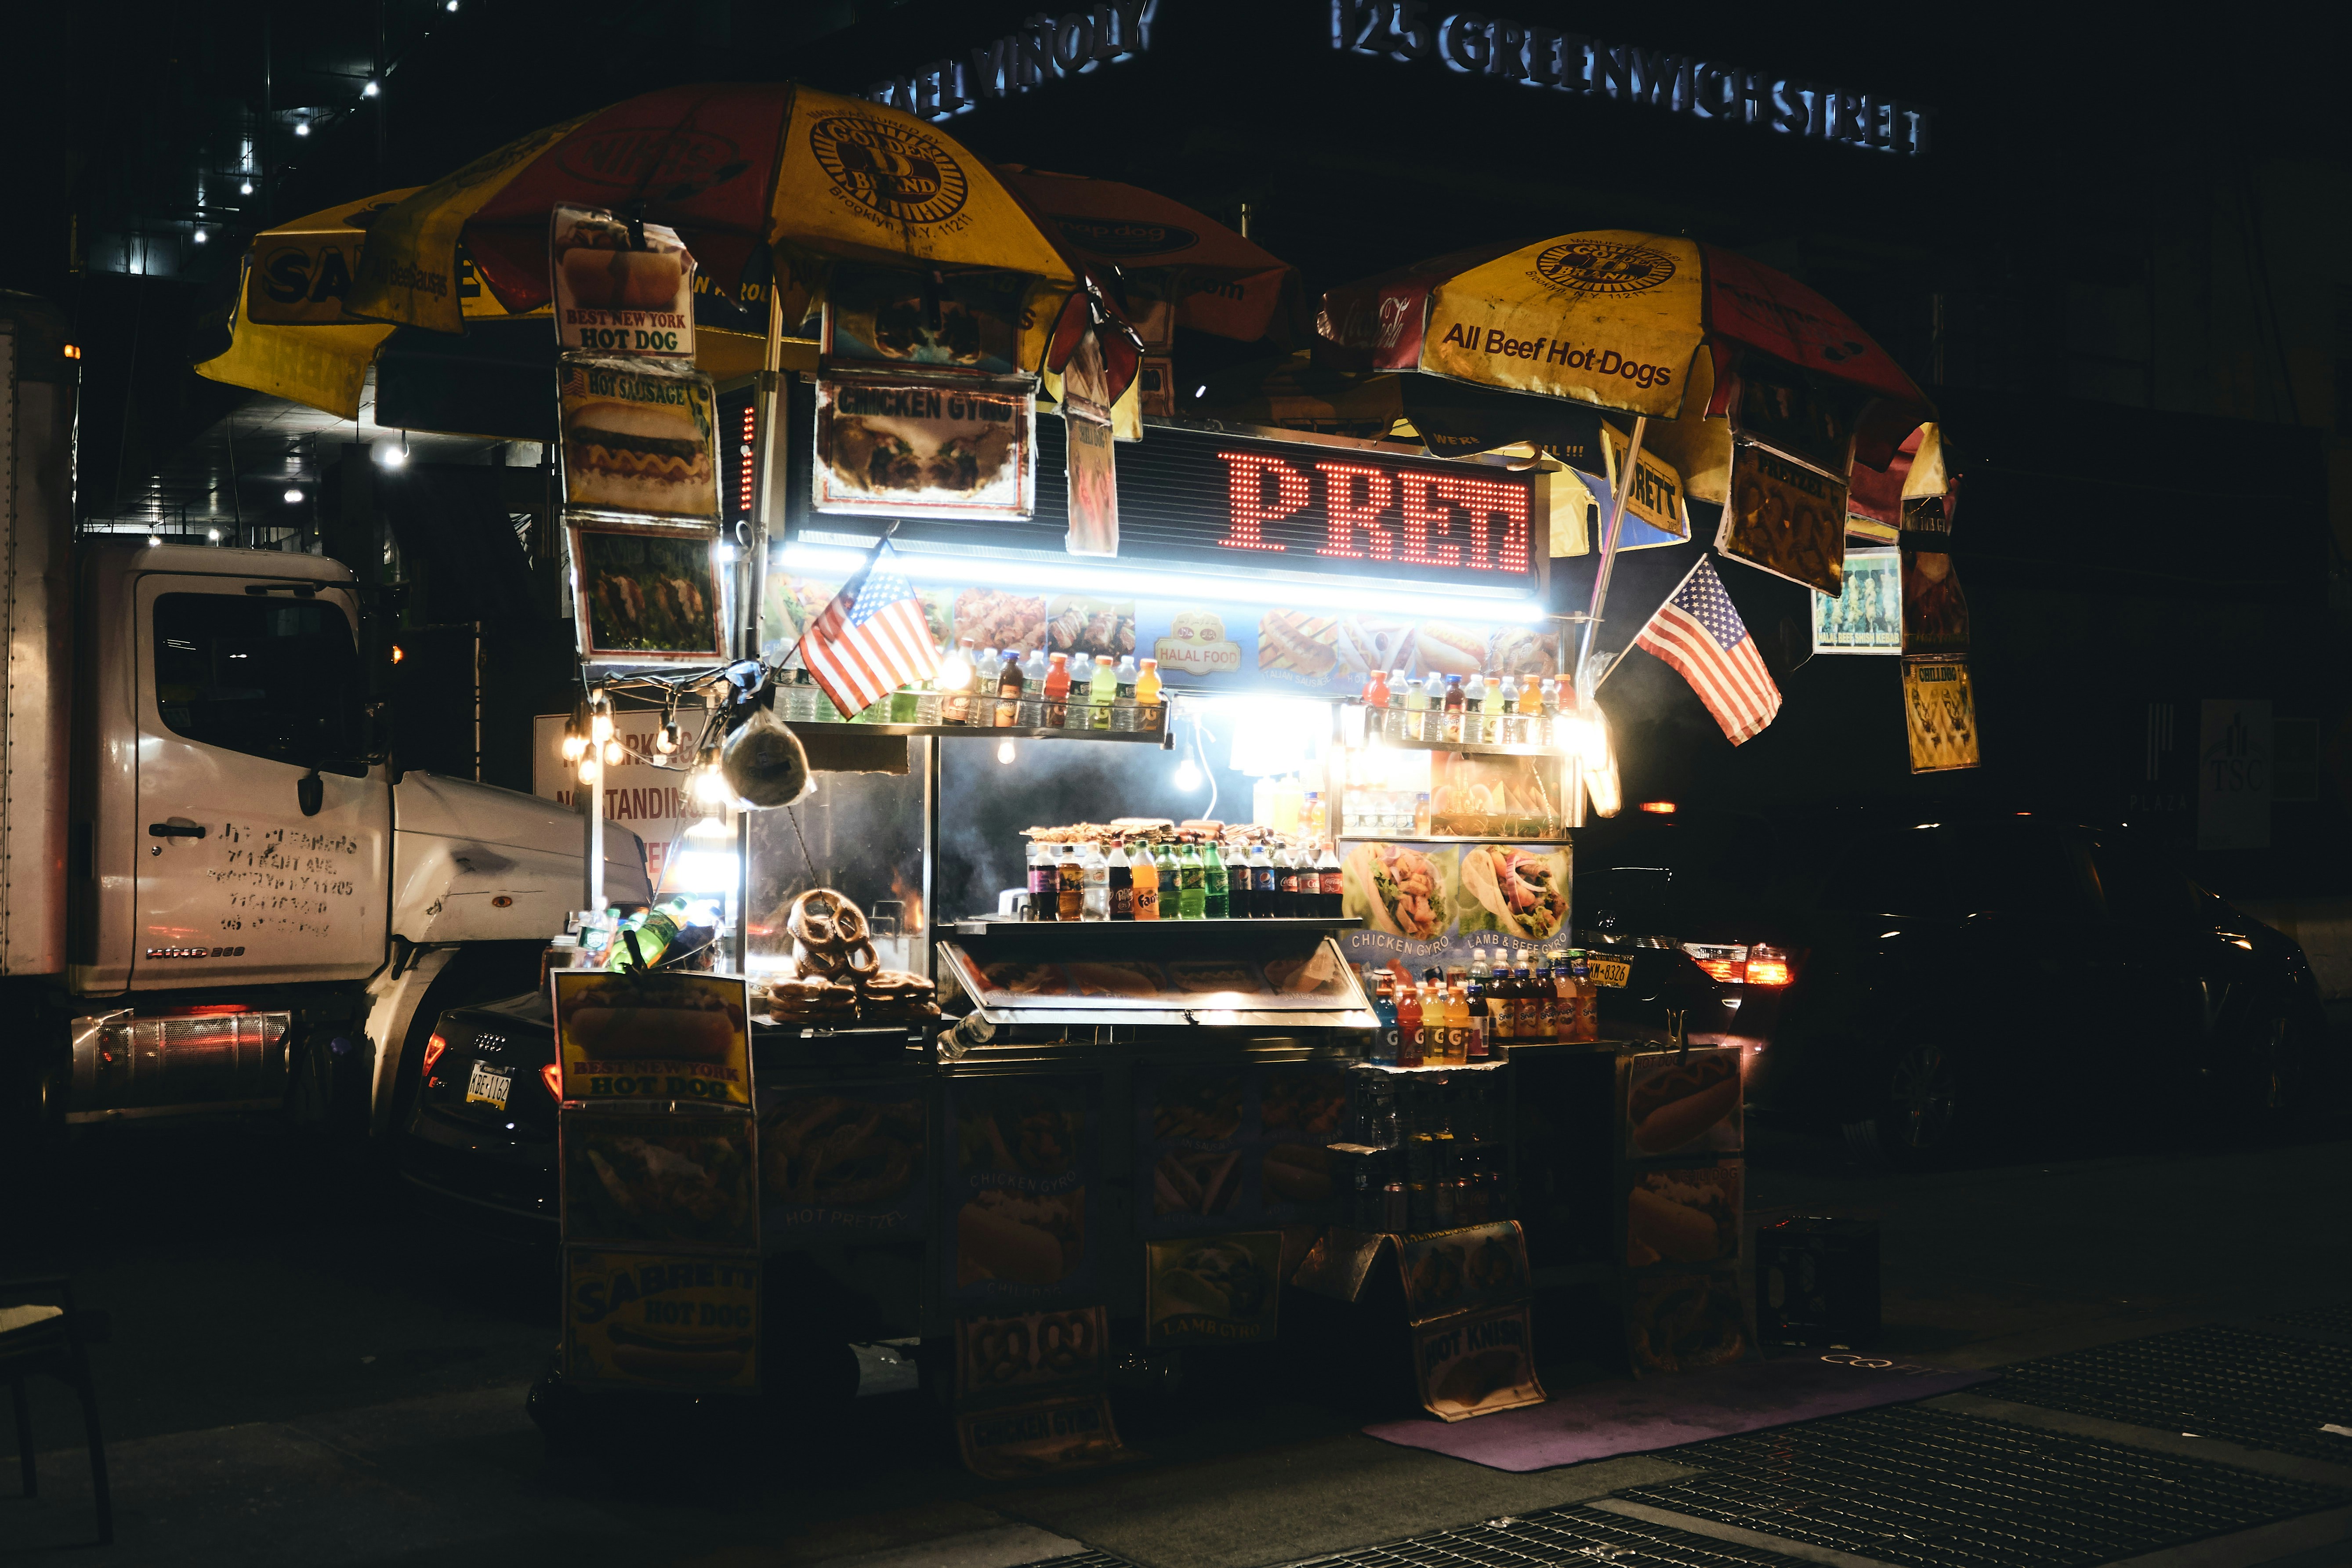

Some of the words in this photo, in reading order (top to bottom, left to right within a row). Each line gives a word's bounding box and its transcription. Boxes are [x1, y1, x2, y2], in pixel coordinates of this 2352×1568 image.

[1331, 0, 1431, 59] 125
[1438, 11, 1768, 123] GREENWICH
[1772, 78, 1939, 155] STREET
[826, 123, 939, 162] GOLDEN
[938, 213, 974, 236] 11211
[1057, 221, 1109, 239] nap
[1114, 225, 1166, 243] dog
[1573, 245, 1662, 269] GOLDEN
[1557, 264, 1637, 281] BRAND
[1608, 290, 1646, 299] 11211
[566, 309, 608, 326] BEST
[613, 310, 648, 326] NEW
[649, 312, 686, 329] YORK
[579, 328, 630, 349] HOT
[635, 330, 678, 351] DOG
[1442, 323, 1479, 351] All
[1484, 328, 1547, 361] Beef
[1546, 339, 1596, 370] Hot
[1598, 350, 1671, 389] Dogs
[588, 371, 616, 396] HOT
[618, 376, 685, 407] SAUSAGE
[839, 386, 941, 419] CHICKEN
[1758, 453, 1826, 500] PRETZEL
[1818, 632, 1837, 642] HALAL
[1837, 632, 1854, 643] BEEF
[1855, 632, 1875, 643] SHISH
[1876, 632, 1899, 645] KEBAB
[1160, 648, 1201, 663] HALAL
[1203, 650, 1237, 664] FOOD
[1261, 669, 1293, 682] ITALIAN
[1294, 672, 1332, 688] SAUSAGE
[996, 699, 1021, 709] Snapp
[1443, 718, 1460, 726] Snap
[2211, 759, 2264, 792] TSC
[2130, 794, 2187, 811] PLAZA
[1138, 892, 1159, 908] Fant
[1351, 933, 1413, 955] CHICKEN
[1416, 934, 1450, 957] GYRO
[1467, 934, 1500, 950] LAMB
[1501, 936, 1510, 948] &
[1512, 938, 1540, 956] BEEF
[1540, 932, 1567, 955] GYRO
[1387, 1030, 1398, 1046] G
[1414, 1028, 1424, 1045] G
[1435, 1028, 1445, 1044] G
[1448, 1029, 1462, 1046] G
[574, 1060, 628, 1075] BEST
[633, 1060, 682, 1075] NEW
[686, 1062, 740, 1082] YORK
[1634, 1057, 1656, 1069] HOT
[590, 1076, 658, 1095] HOT
[665, 1076, 728, 1098] DOG
[970, 1173, 1036, 1191] CHICKEN
[1040, 1170, 1076, 1192] GYRO
[1712, 1166, 1738, 1181] DOG
[786, 1208, 826, 1227] HOT
[830, 1209, 908, 1230] PRETZEL
[571, 1258, 755, 1325] SABRETT
[987, 1282, 1027, 1297] CHILI
[1033, 1286, 1062, 1300] DOG
[644, 1301, 695, 1326] HOT
[699, 1302, 750, 1327] DOG
[1163, 1318, 1217, 1336] LAMB
[1220, 1322, 1261, 1340] GYRO
[1425, 1329, 1462, 1373] HOT
[1467, 1319, 1524, 1352] KNISH
[973, 1412, 1051, 1448] CHICKEN
[1054, 1406, 1100, 1436] GYRO
